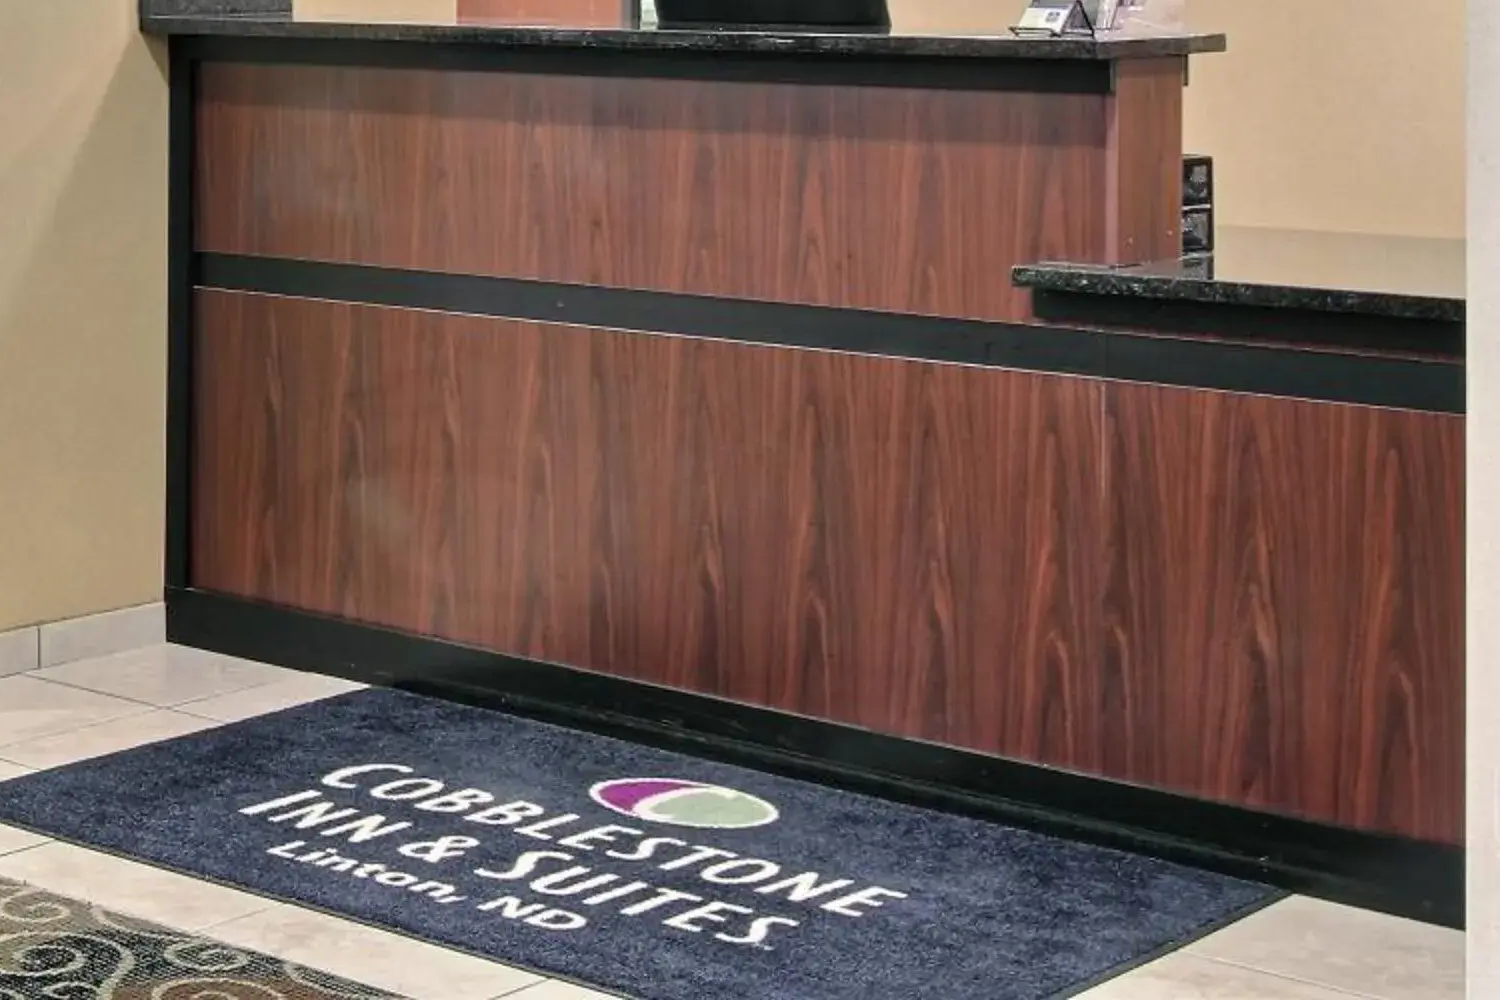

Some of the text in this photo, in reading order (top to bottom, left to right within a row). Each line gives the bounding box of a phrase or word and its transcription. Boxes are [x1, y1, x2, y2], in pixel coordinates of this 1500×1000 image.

[239, 789, 800, 946] INN & SUITES
[267, 840, 588, 931] Linton, ND
[321, 763, 907, 917] COBBLESTONE
